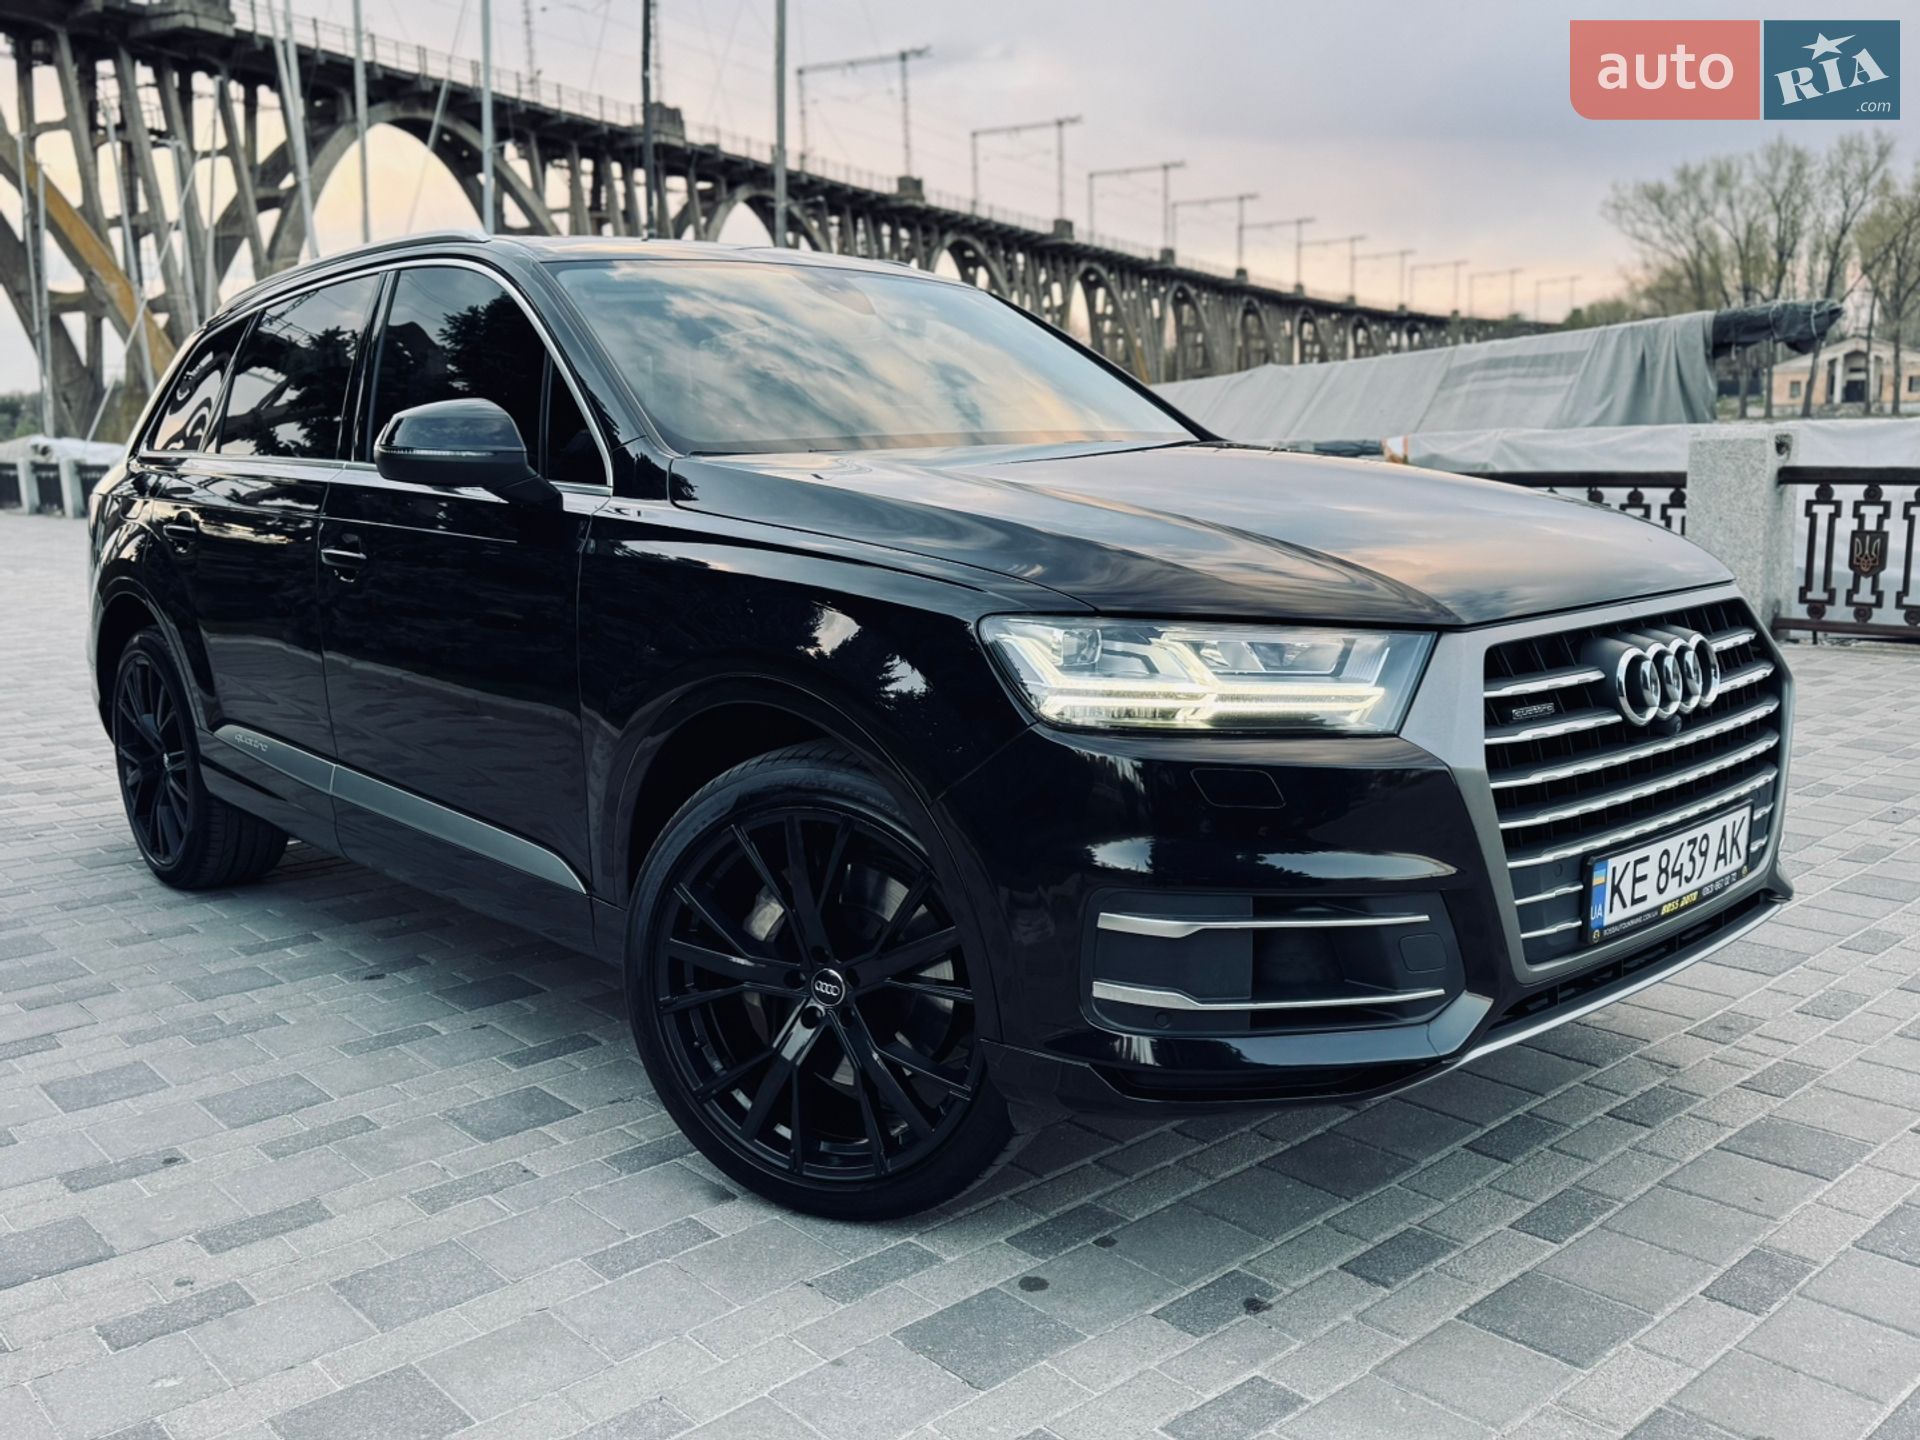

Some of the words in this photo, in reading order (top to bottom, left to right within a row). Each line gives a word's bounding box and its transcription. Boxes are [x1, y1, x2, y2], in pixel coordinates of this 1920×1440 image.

[1609, 855, 1650, 914] KE
[1656, 833, 1710, 895] 8439
[1714, 816, 1746, 872] AK
[1590, 903, 1603, 920] UA
